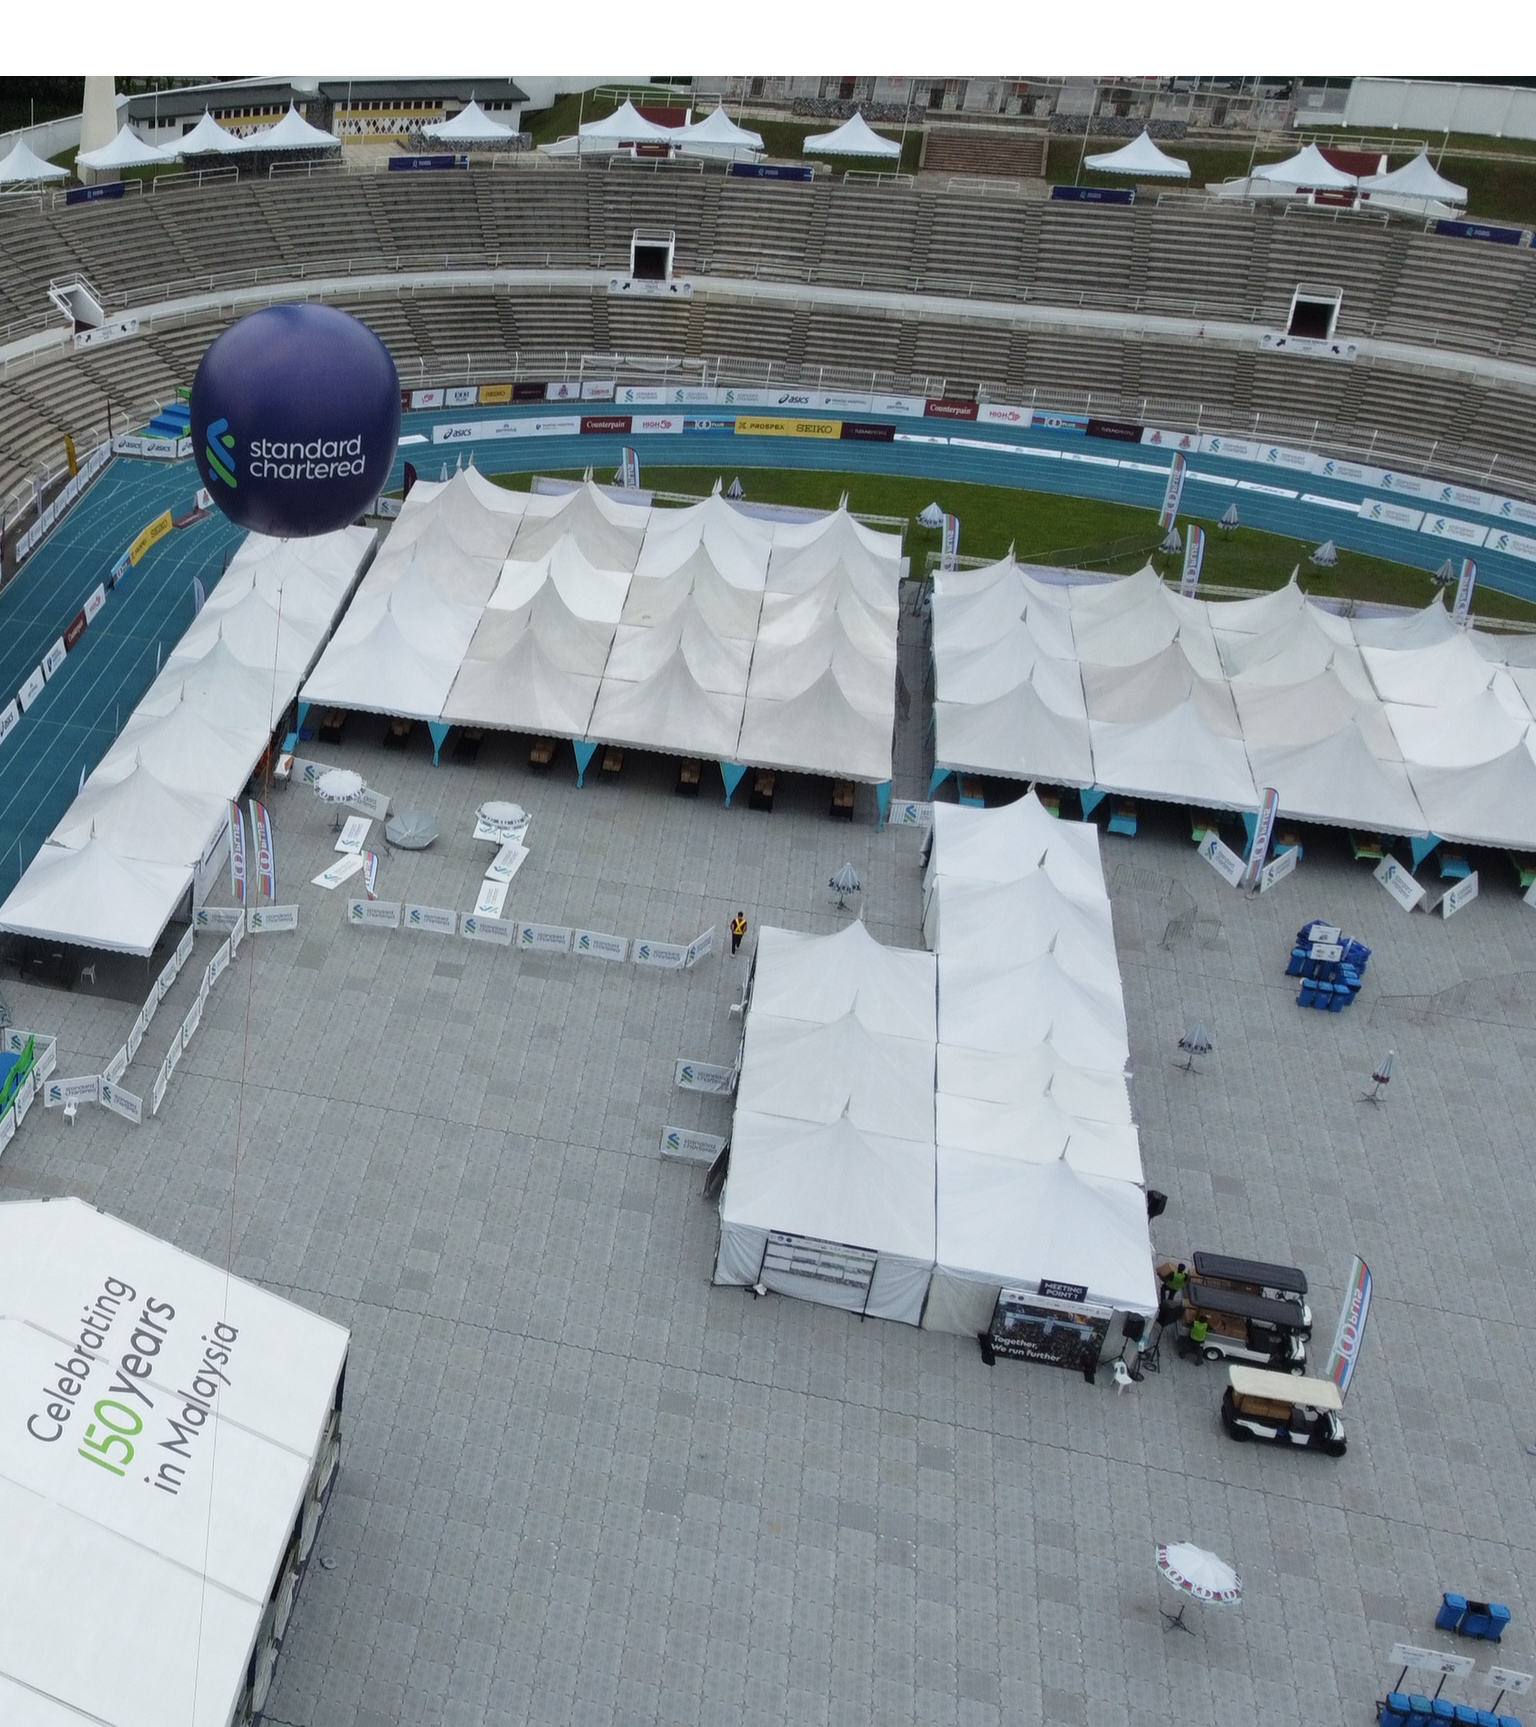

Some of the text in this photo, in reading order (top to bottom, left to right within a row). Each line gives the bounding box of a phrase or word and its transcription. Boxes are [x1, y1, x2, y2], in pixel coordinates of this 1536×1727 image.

[787, 394, 810, 405] asics
[929, 402, 974, 417] Counterpain
[586, 419, 625, 430] Counterpain
[749, 423, 786, 431] PROSPEX
[796, 424, 833, 435] SEIKO
[453, 427, 472, 438] asics
[250, 434, 362, 462] standard
[249, 456, 367, 480] chartered
[1044, 1282, 1083, 1295] MEETING
[1046, 1289, 1072, 1300] POINT
[993, 1334, 1039, 1350] Together,
[25, 1274, 137, 1443] Celebrating
[990, 1342, 1061, 1363] We run further
[78, 1297, 177, 1478] 150 years
[153, 1321, 240, 1495] in Malaysia
